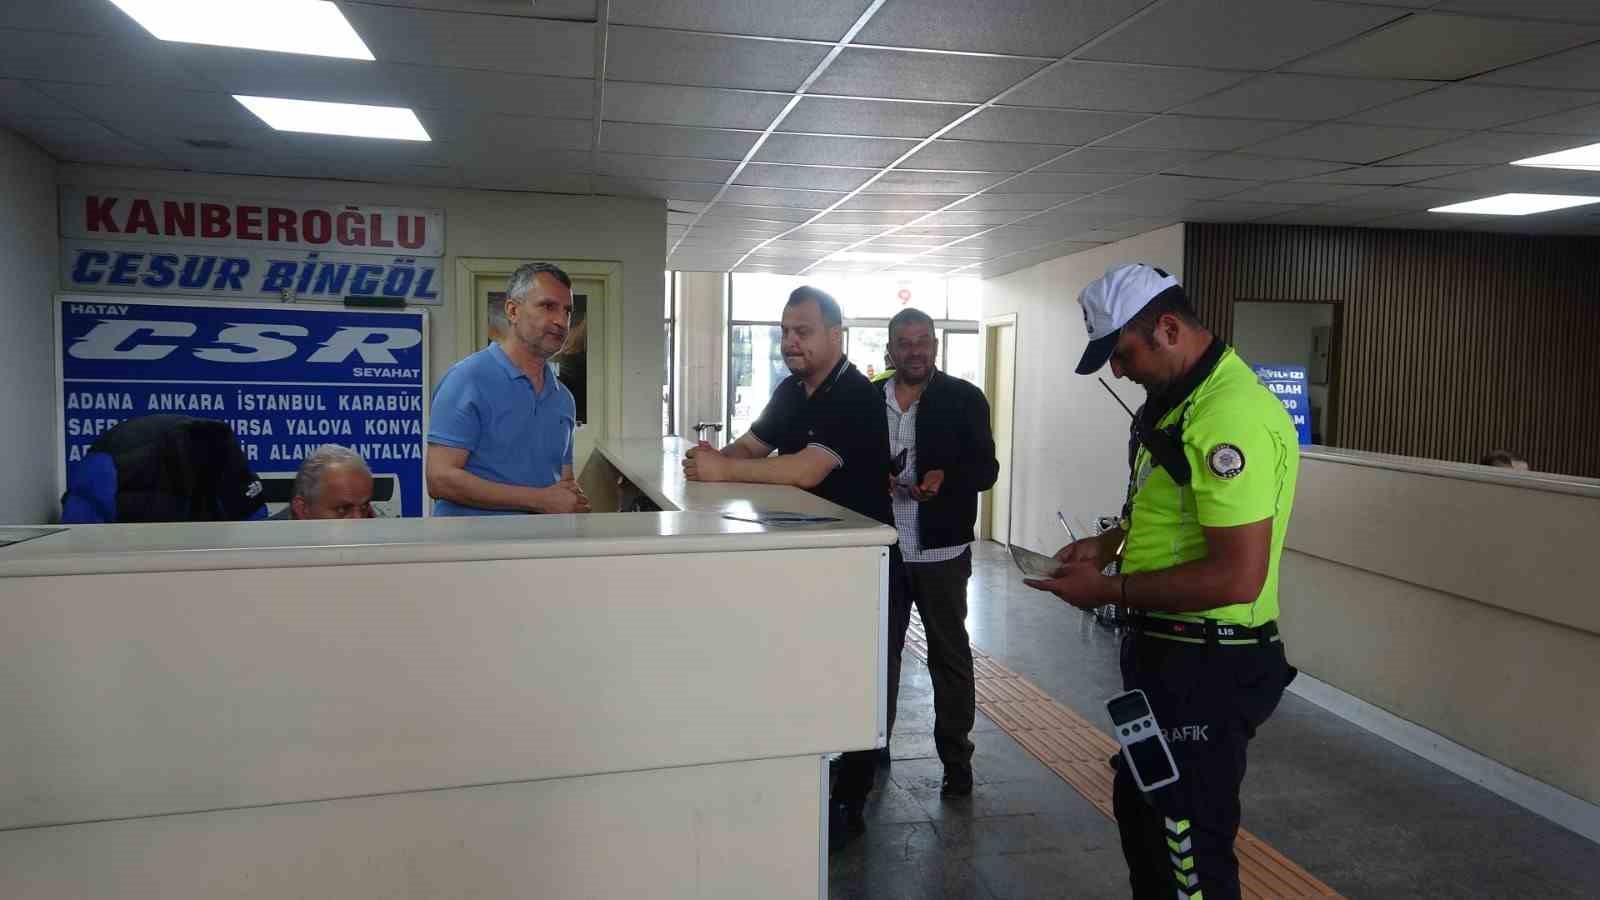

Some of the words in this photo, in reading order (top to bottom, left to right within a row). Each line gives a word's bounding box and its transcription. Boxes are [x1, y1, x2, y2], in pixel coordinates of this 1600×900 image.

[85, 195, 427, 250] KANBEROĞLU
[71, 249, 251, 292] CESUR
[260, 252, 441, 300] BİNGÖL
[70, 303, 129, 317] HATAY
[67, 319, 422, 364] CSR
[352, 366, 421, 379] SEYAHAT
[1268, 384, 1302, 395] ABAH
[67, 392, 134, 411] ADANA
[147, 393, 225, 411] ANKARA
[237, 389, 327, 412] İSTANBUL
[338, 391, 422, 413] KARABÜK
[1282, 399, 1297, 410] 30
[286, 418, 352, 436] YALOVA
[364, 418, 422, 436] KONYA
[269, 443, 321, 461] ALAN
[1160, 724, 1209, 743] RAFİK
